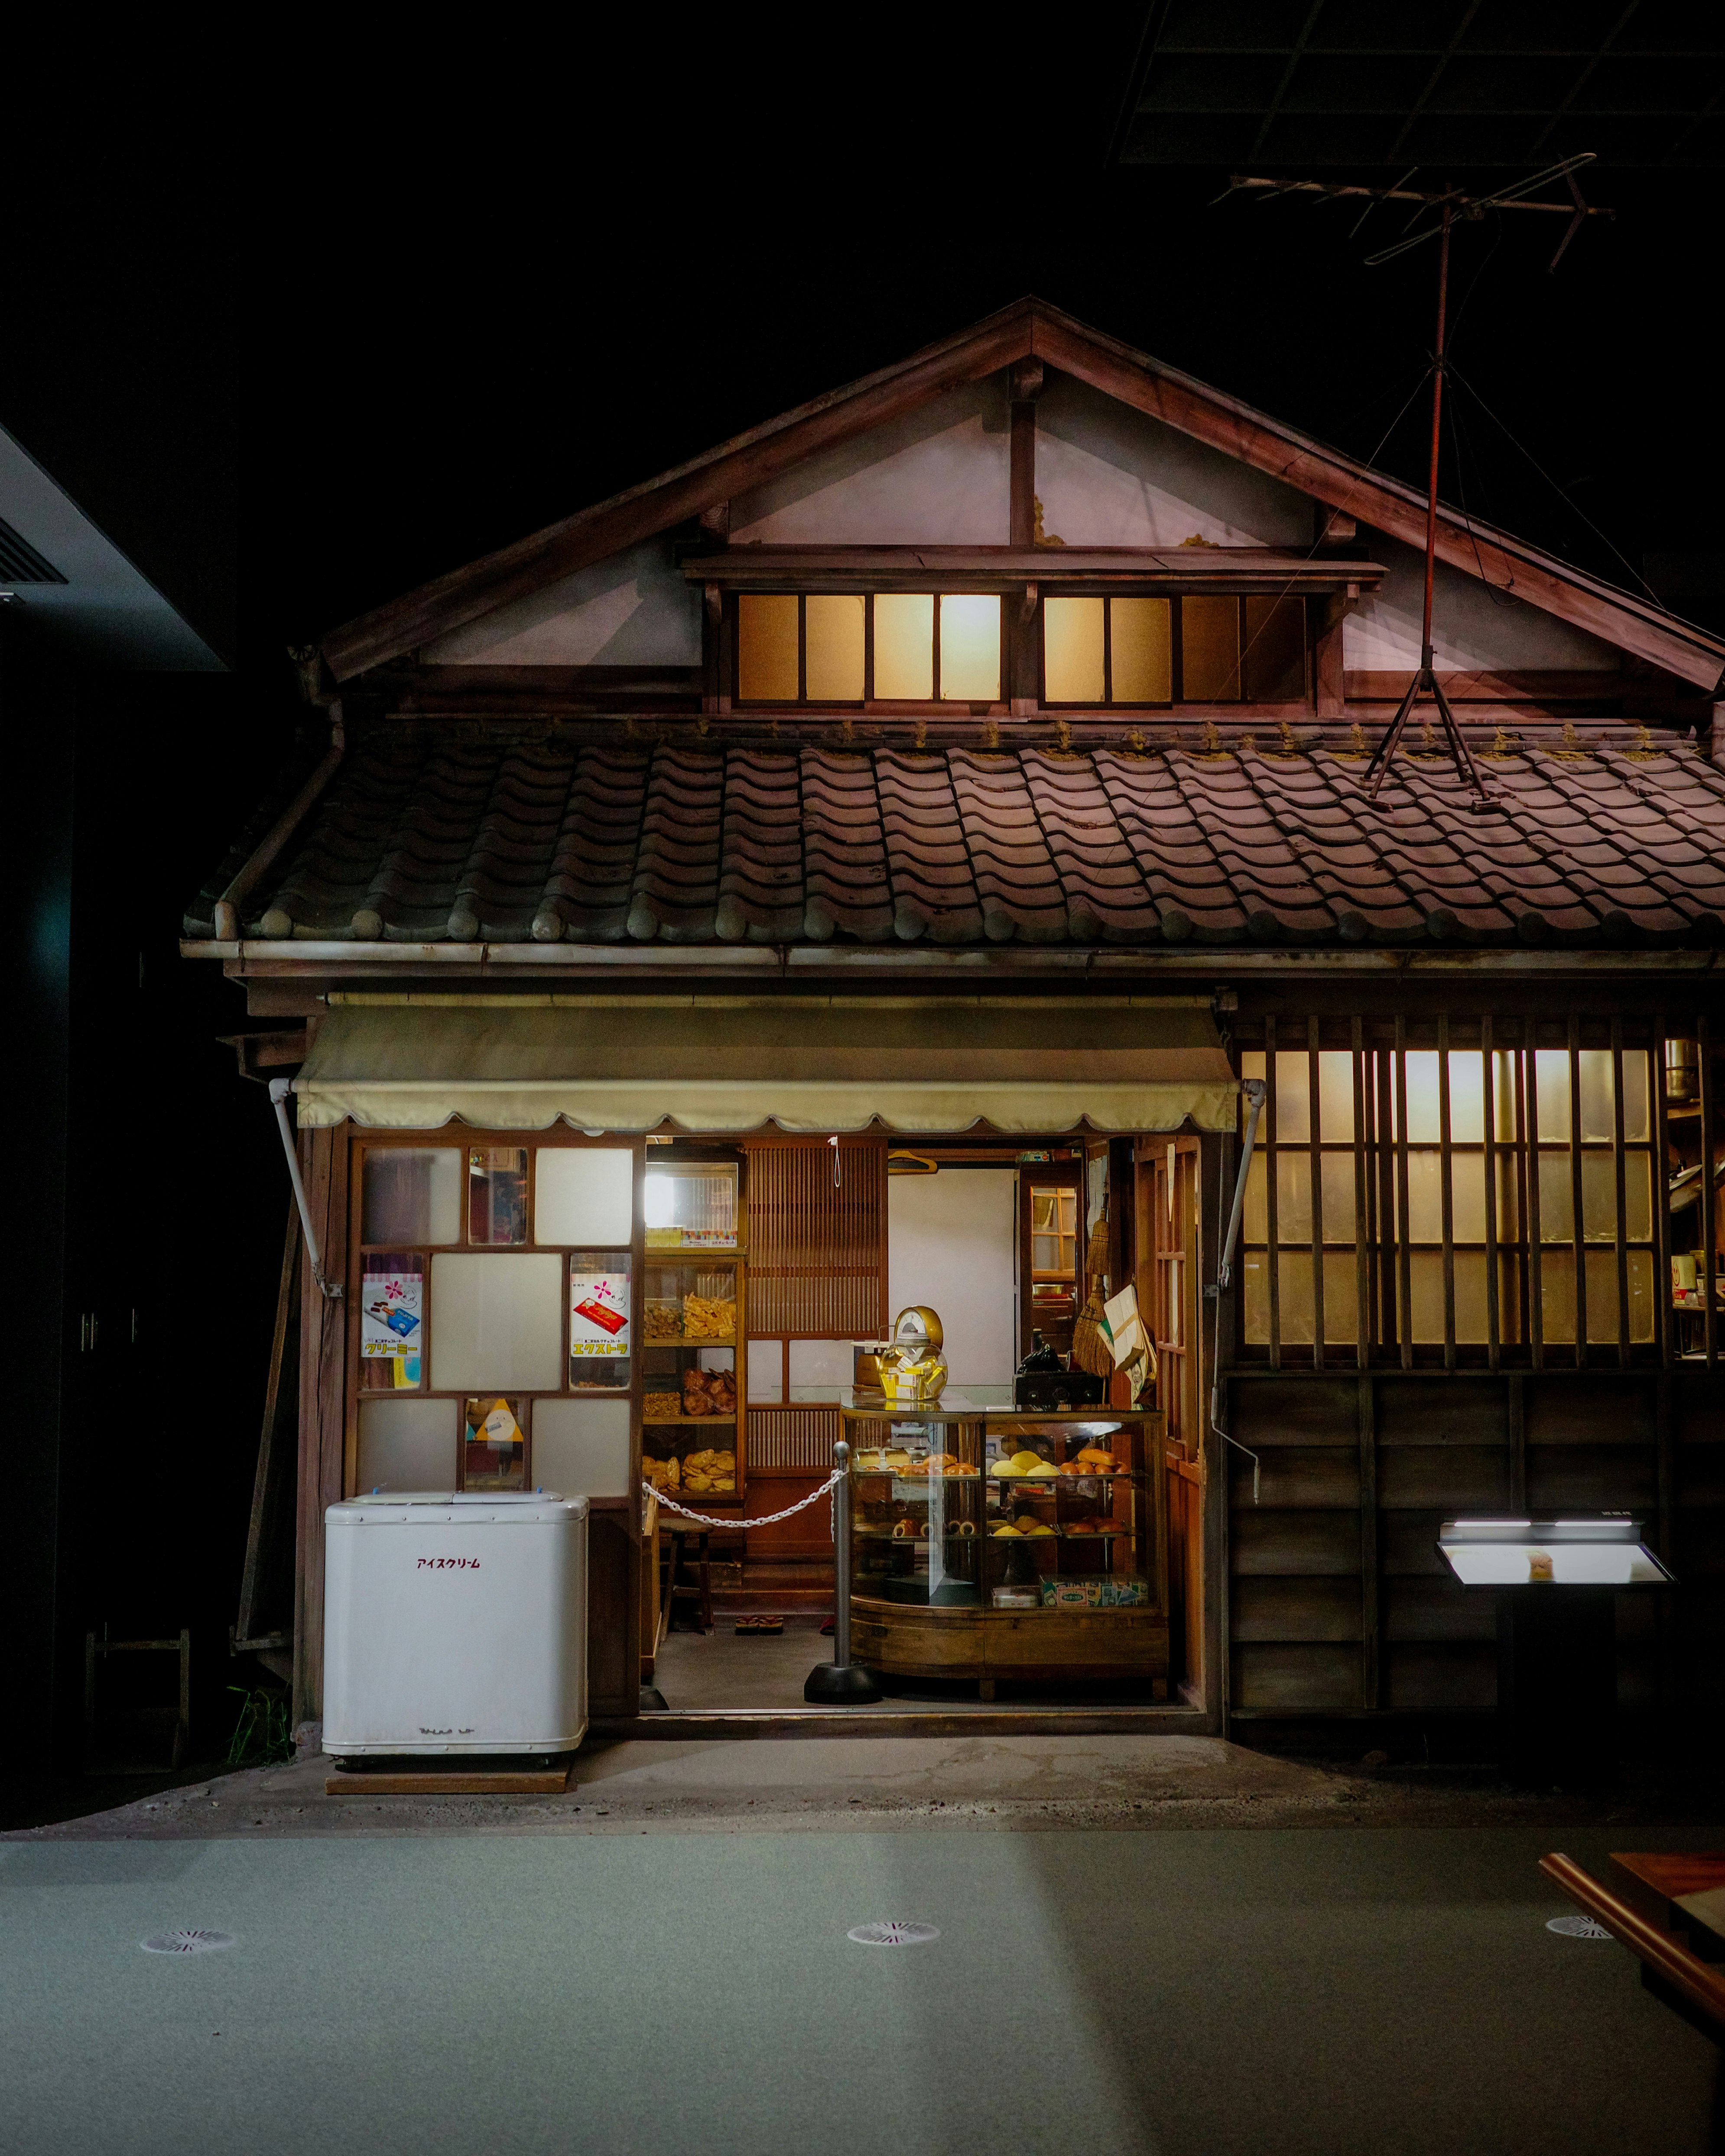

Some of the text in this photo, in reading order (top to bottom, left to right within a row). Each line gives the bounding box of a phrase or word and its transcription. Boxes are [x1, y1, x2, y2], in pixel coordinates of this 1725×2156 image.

[365, 1344, 417, 1355] クリーミー
[573, 1344, 627, 1355] エクストラ
[417, 1558, 481, 1569] アイスクリーム
